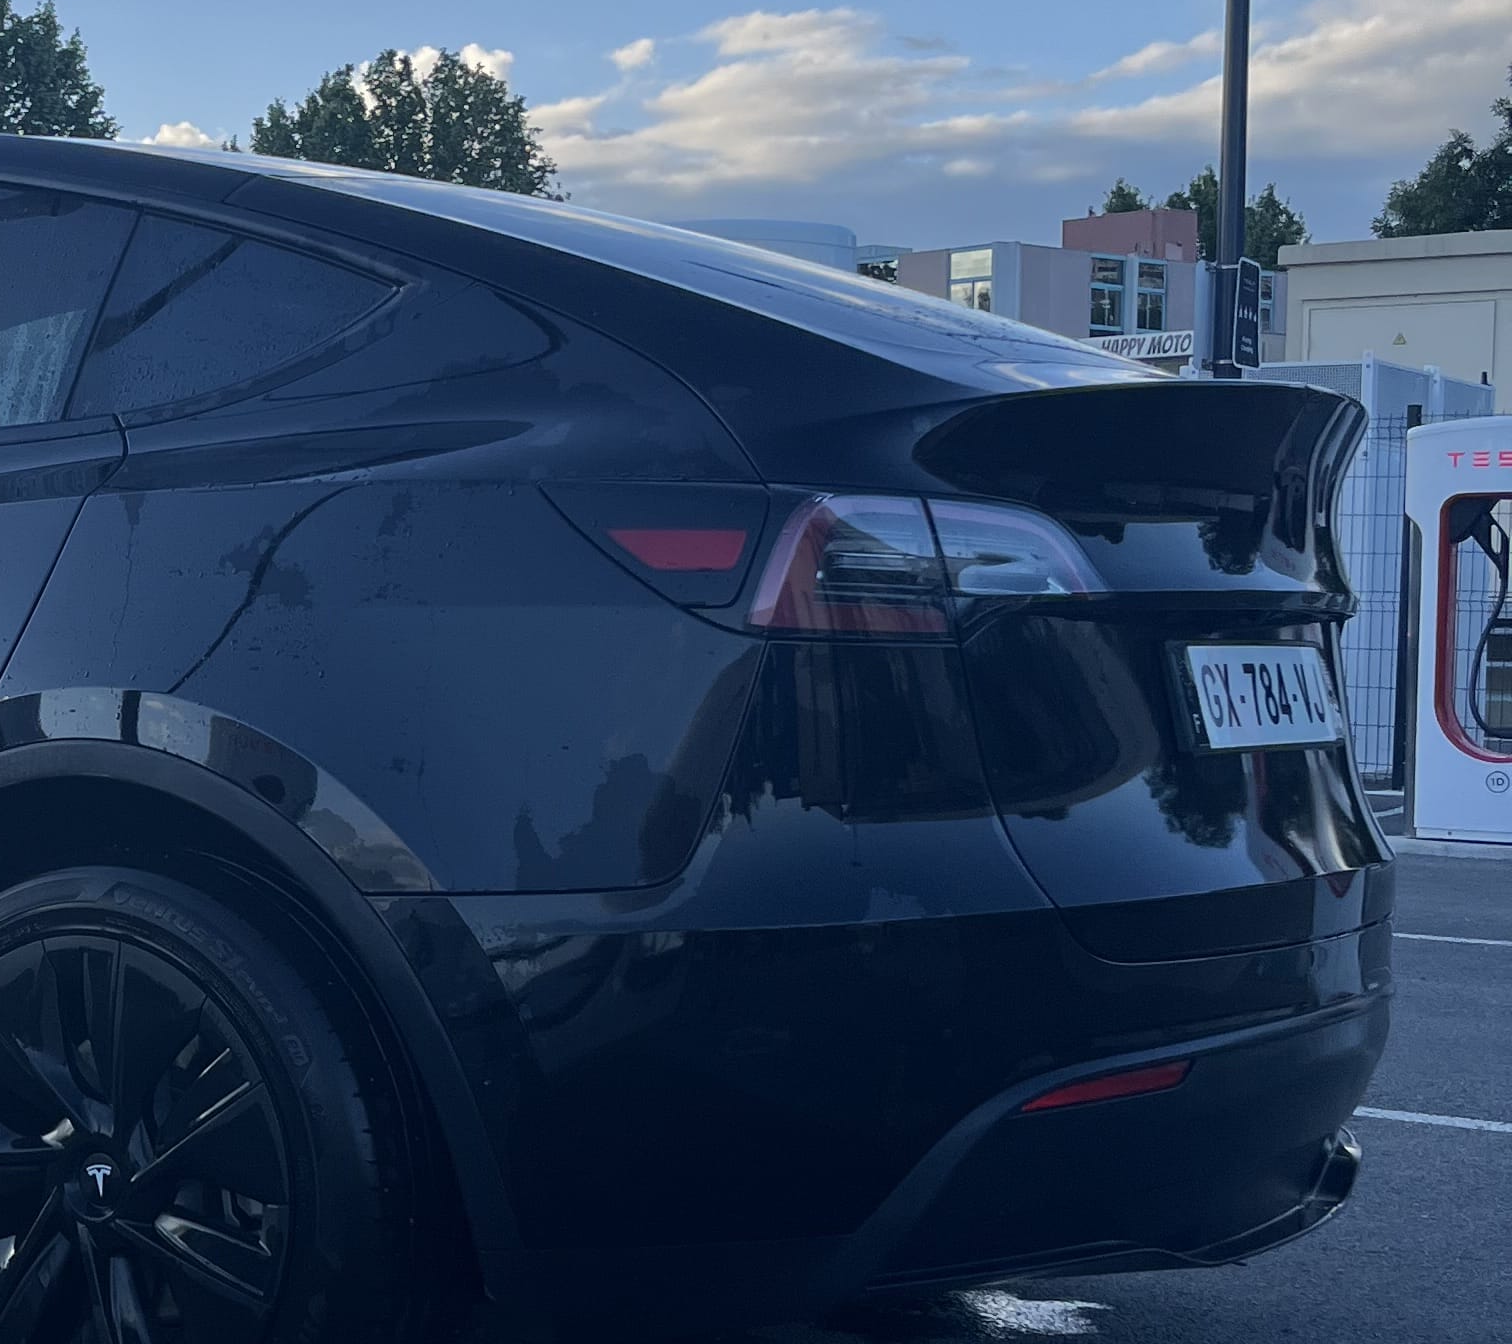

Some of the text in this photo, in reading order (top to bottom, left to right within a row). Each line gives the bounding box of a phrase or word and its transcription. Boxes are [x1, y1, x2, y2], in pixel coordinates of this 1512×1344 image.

[1102, 334, 1192, 356] HAPPY MOTO
[1201, 663, 1325, 728] GX-784-VJ
[1192, 713, 1201, 734] F
[1490, 777, 1505, 786] 1D
